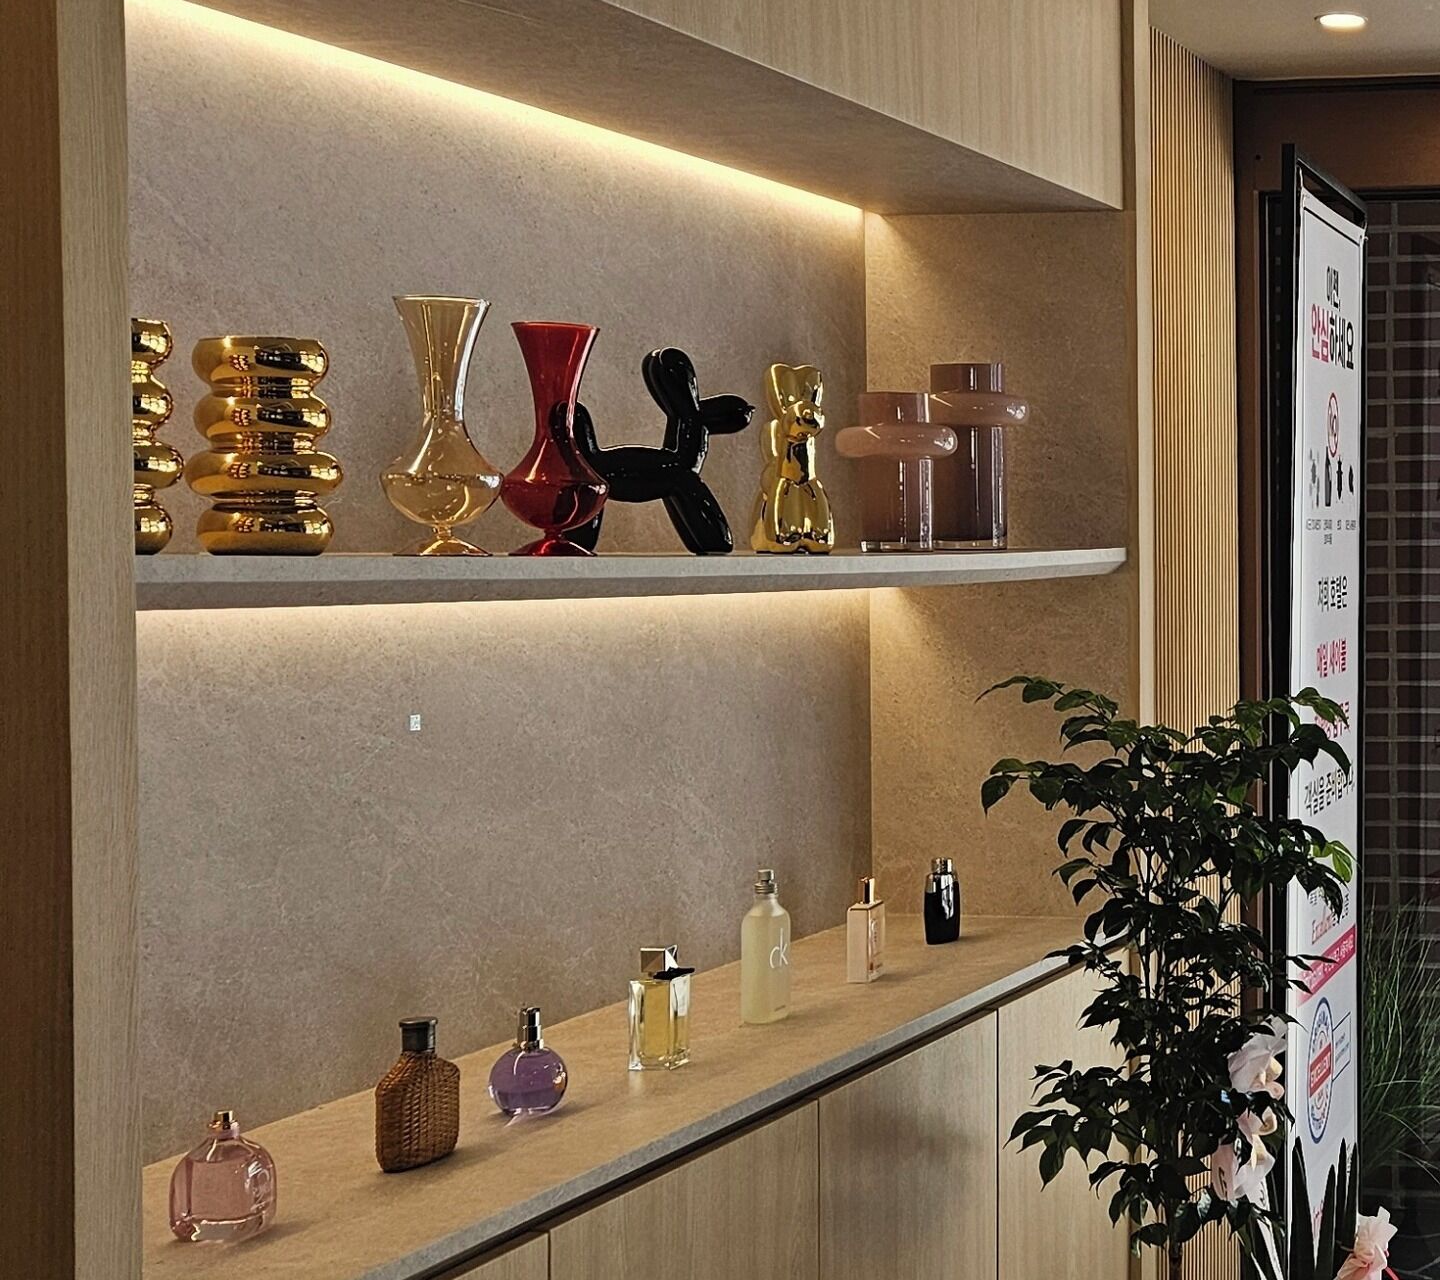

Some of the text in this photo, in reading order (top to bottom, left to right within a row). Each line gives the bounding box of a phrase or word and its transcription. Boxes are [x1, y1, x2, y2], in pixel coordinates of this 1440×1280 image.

[1311, 303, 1354, 371] 안심하세요
[1317, 575, 1348, 612] 저희 호텔은
[1316, 641, 1328, 678] 매일
[1304, 776, 1325, 816] 객실을
[769, 927, 789, 969] ck
